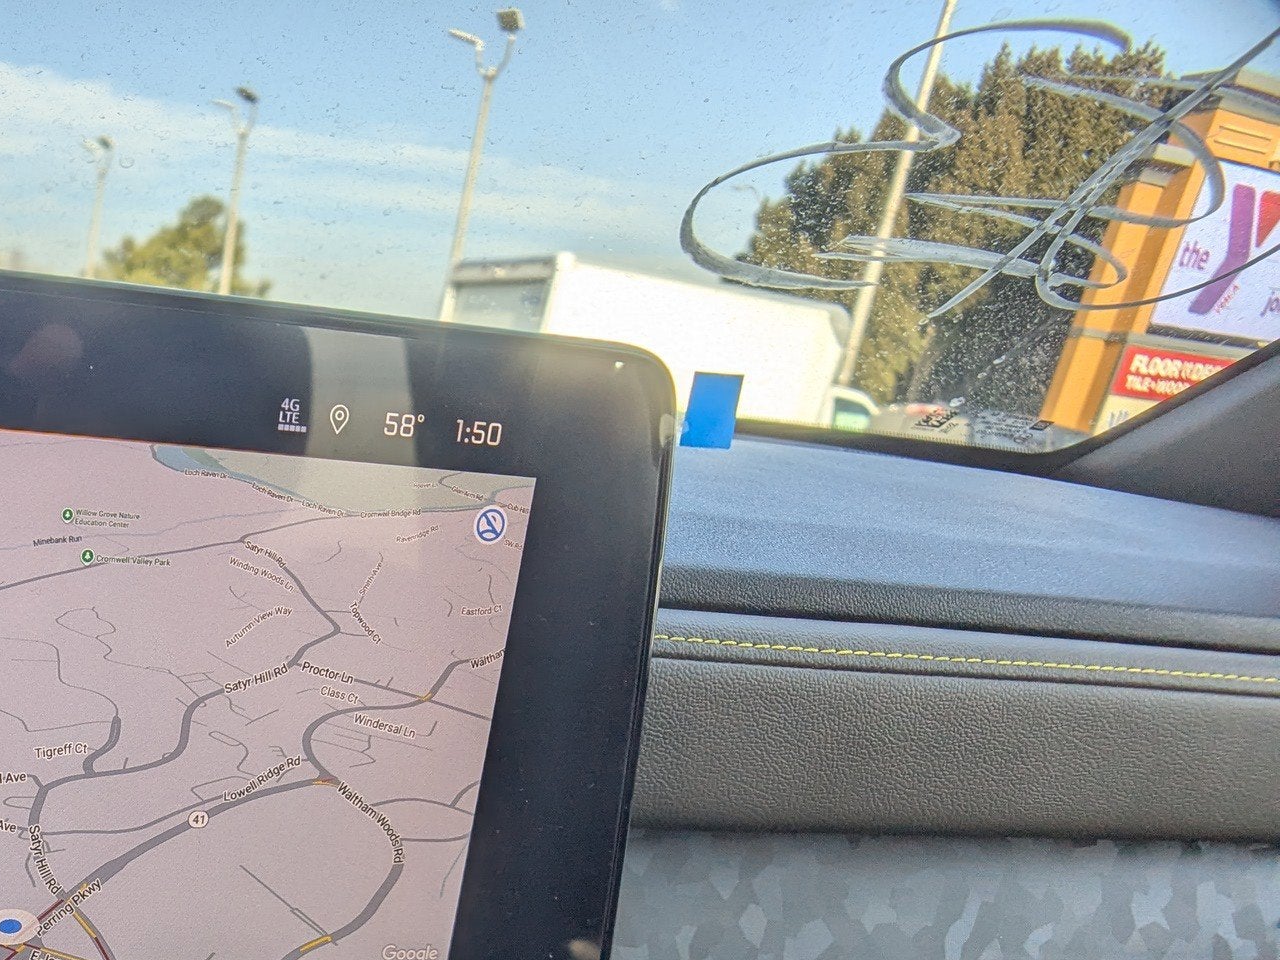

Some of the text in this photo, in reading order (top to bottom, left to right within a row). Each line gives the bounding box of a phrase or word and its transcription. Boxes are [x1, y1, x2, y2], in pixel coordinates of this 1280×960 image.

[281, 398, 300, 412] 4G
[279, 411, 299, 424] LTE
[384, 411, 425, 437] 58°
[456, 419, 503, 446] 1:50
[201, 470, 219, 478] Raven
[252, 482, 294, 503] Loch Raven Dr
[76, 508, 140, 521] Willow Grove Nature
[302, 500, 345, 517] Loch Raven Dr
[360, 511, 390, 519] Cromwell
[391, 510, 411, 518] Bridge
[74, 518, 130, 529] Education Center
[430, 525, 439, 533] Rd
[33, 534, 83, 547] Minebank Run
[96, 555, 171, 567] Cromwell Valley Park
[245, 541, 287, 569] Satyr Hill Rd
[229, 556, 294, 592] Winding Woods Ln
[358, 562, 383, 596] Smith Ave
[461, 604, 502, 616] Eastford Ct
[226, 606, 293, 648] Autumn View Way
[349, 601, 381, 644] Topwood Ct
[224, 663, 288, 694] Satyr Hill Rd
[301, 661, 354, 684] Proctor Ln
[320, 686, 359, 704] Class Ct
[353, 713, 416, 738] Windersal Ln
[35, 742, 88, 760] Tigreff Ct
[4, 772, 27, 784] Ave
[223, 756, 301, 801] Lowell Ridge Rd
[192, 814, 206, 825] 41
[338, 781, 404, 864] Waltham Woods Rd
[28, 824, 63, 896] Satyr Hill Rd
[37, 878, 102, 936] Perring Pkwy
